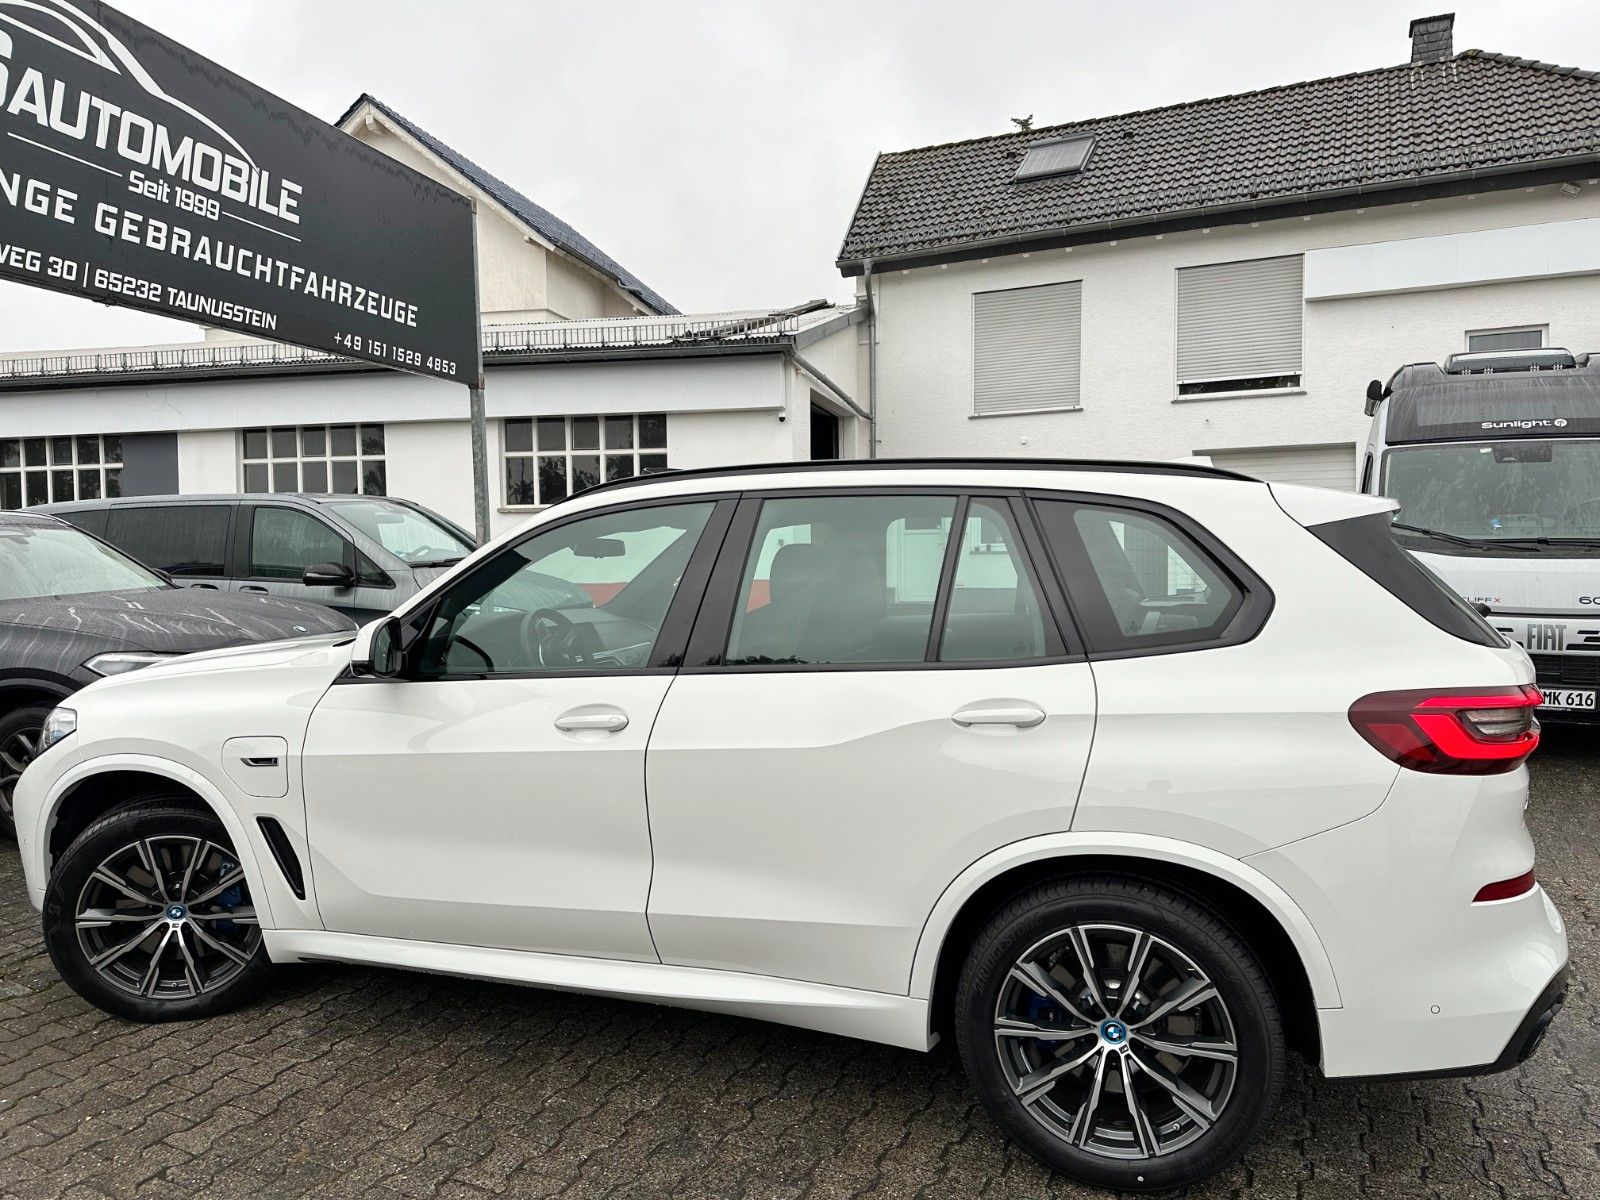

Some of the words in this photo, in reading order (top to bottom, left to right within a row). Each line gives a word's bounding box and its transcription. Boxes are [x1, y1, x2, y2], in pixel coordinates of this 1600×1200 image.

[128, 170, 171, 203] Seit
[175, 186, 220, 221] 1999
[94, 202, 418, 328] GEBRAUCHTFAHRZEUGE
[47, 256, 78, 281] 30
[94, 268, 162, 302] 65232
[167, 287, 277, 331] TAUNUSSTEIN
[334, 332, 362, 351] +49
[368, 340, 387, 357] 151
[392, 346, 422, 366] 1529
[426, 356, 457, 375] 4853
[1481, 420, 1552, 429] Sunlight
[1526, 623, 1567, 650] FIAT
[1543, 691, 1562, 705] MK
[1565, 692, 1594, 707] 616
